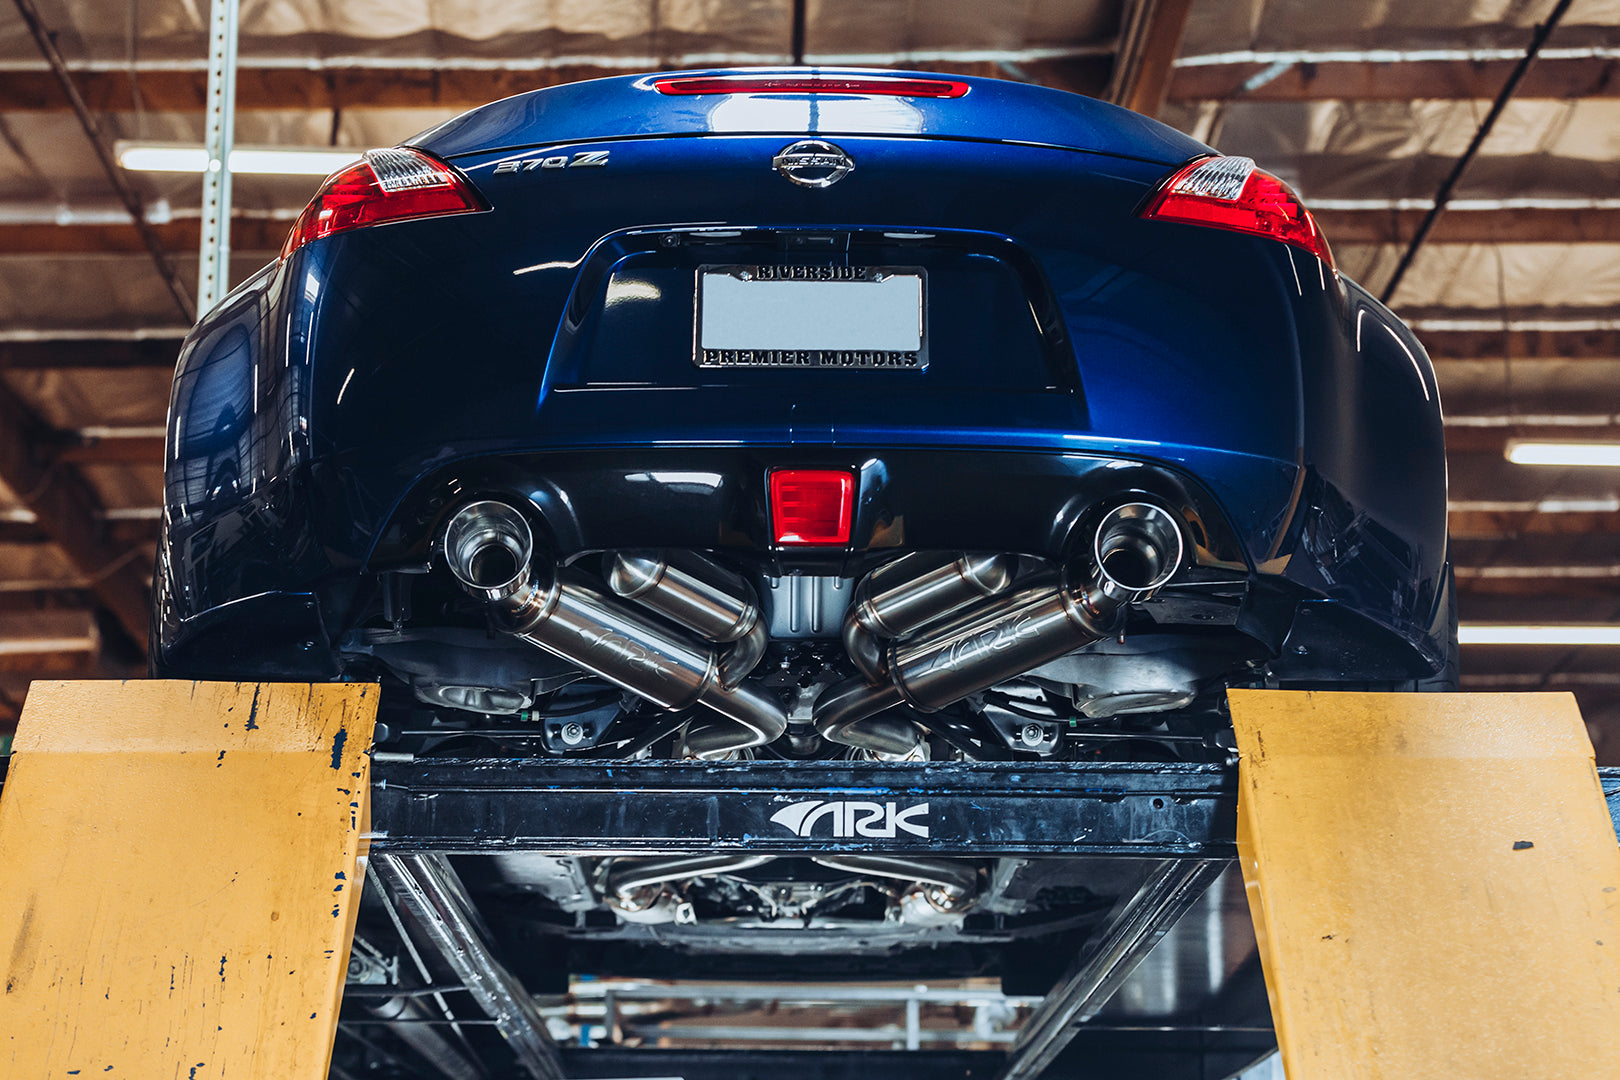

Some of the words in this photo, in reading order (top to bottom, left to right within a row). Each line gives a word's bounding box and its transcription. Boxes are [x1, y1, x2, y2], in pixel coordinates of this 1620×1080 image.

[493, 150, 610, 174] 370Z
[756, 265, 867, 281] RIVERSIDE
[703, 350, 810, 366] PREMIER
[819, 350, 917, 367] MOTORS
[770, 800, 930, 839] ARK
